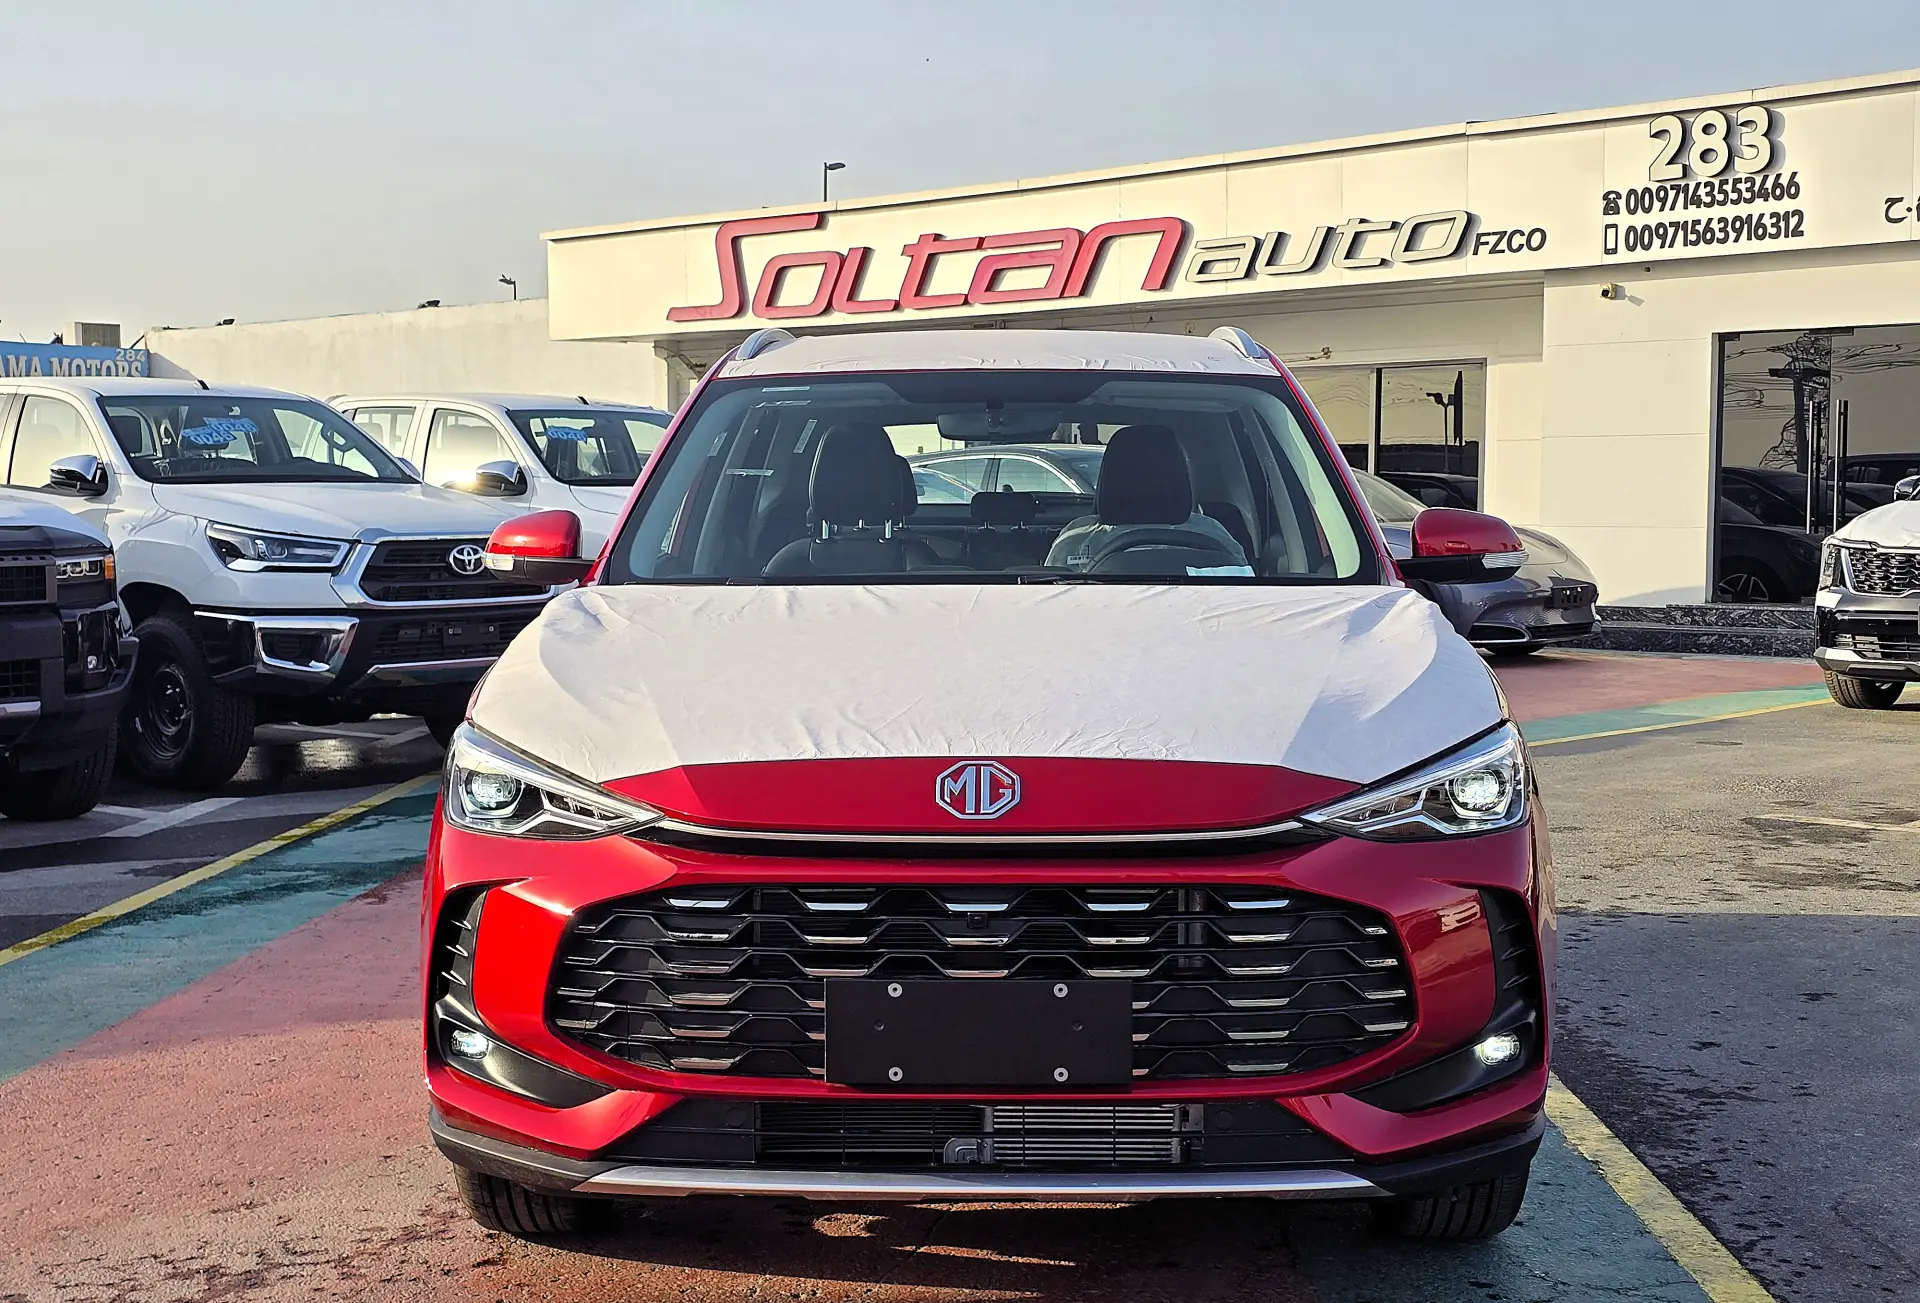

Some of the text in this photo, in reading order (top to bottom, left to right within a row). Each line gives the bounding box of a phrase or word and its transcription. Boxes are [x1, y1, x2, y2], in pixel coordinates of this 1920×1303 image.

[1649, 104, 1775, 182] 283
[1625, 171, 1800, 216] 0097143553466
[1185, 209, 1473, 283] auto
[1472, 228, 1548, 256] FZCO
[1624, 209, 1805, 252] 00971563916312
[50, 356, 143, 377] MOTORS
[115, 348, 146, 363] 284
[944, 765, 1012, 814] MG
